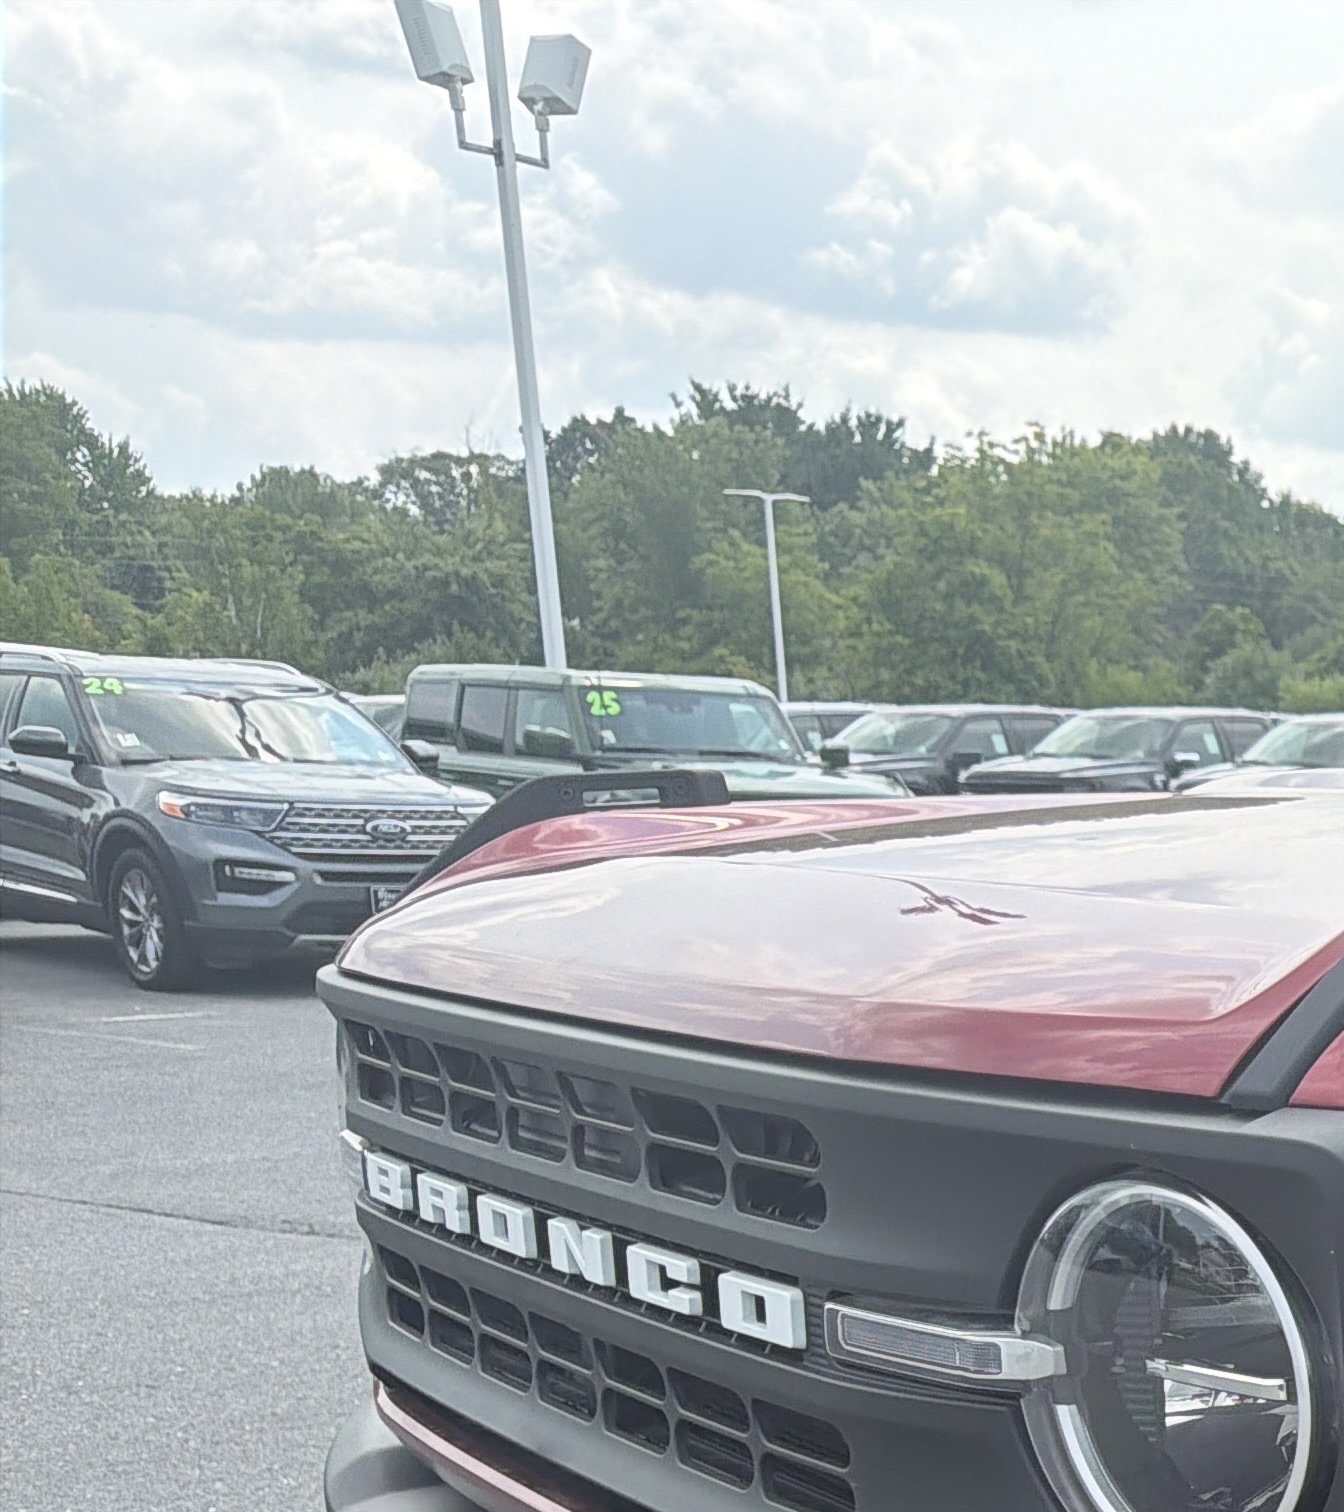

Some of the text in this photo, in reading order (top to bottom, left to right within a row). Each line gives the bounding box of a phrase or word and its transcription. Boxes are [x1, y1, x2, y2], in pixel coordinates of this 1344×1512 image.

[82, 677, 123, 695] 24
[586, 690, 621, 716] 25
[364, 1148, 808, 1350] BRONCO
